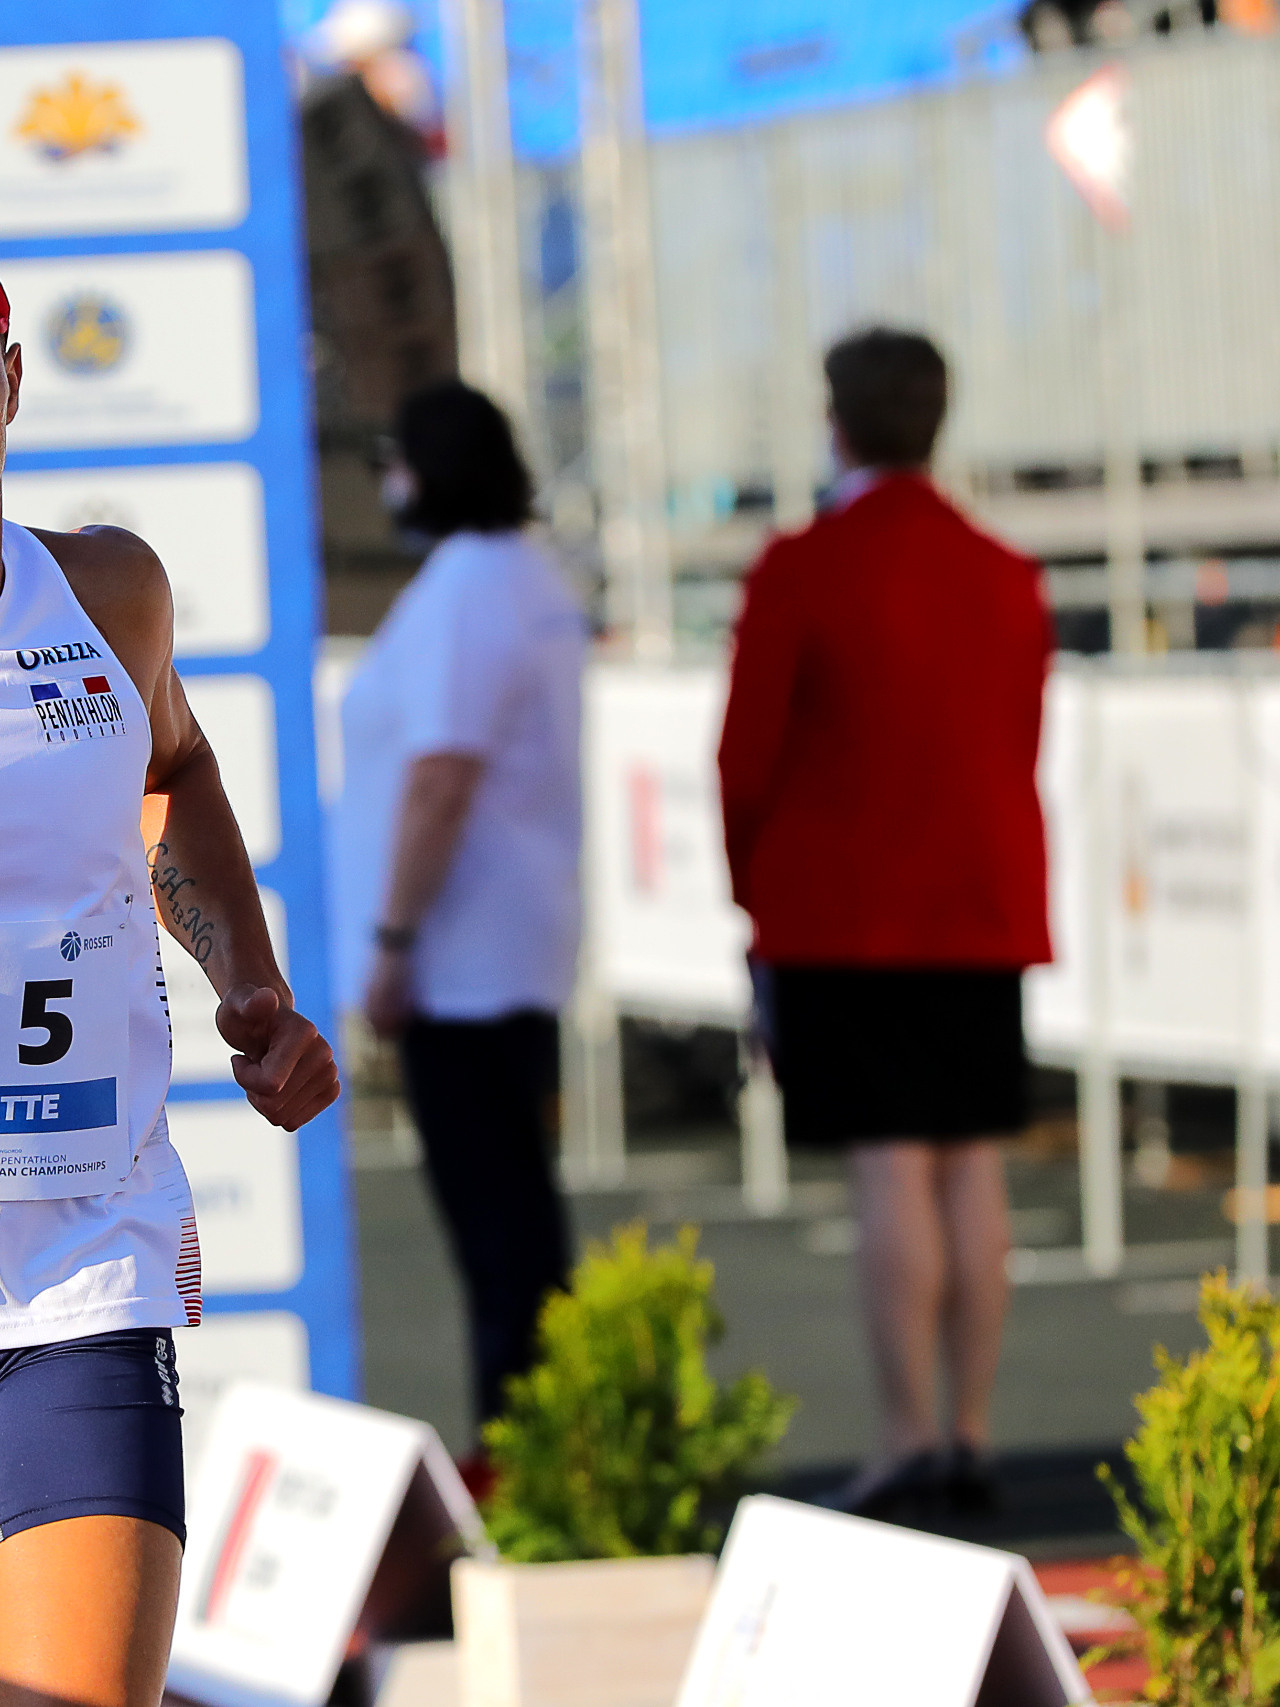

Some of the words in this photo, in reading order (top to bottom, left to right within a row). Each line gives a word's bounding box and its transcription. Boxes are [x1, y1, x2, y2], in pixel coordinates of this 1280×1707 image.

[16, 641, 102, 671] OREZZA
[35, 694, 123, 730] PENTATHLON
[83, 935, 114, 951] ROSSETI
[1, 1154, 67, 1165] PENTATHLON
[20, 1160, 107, 1177] CHAMPIONSHIPS
